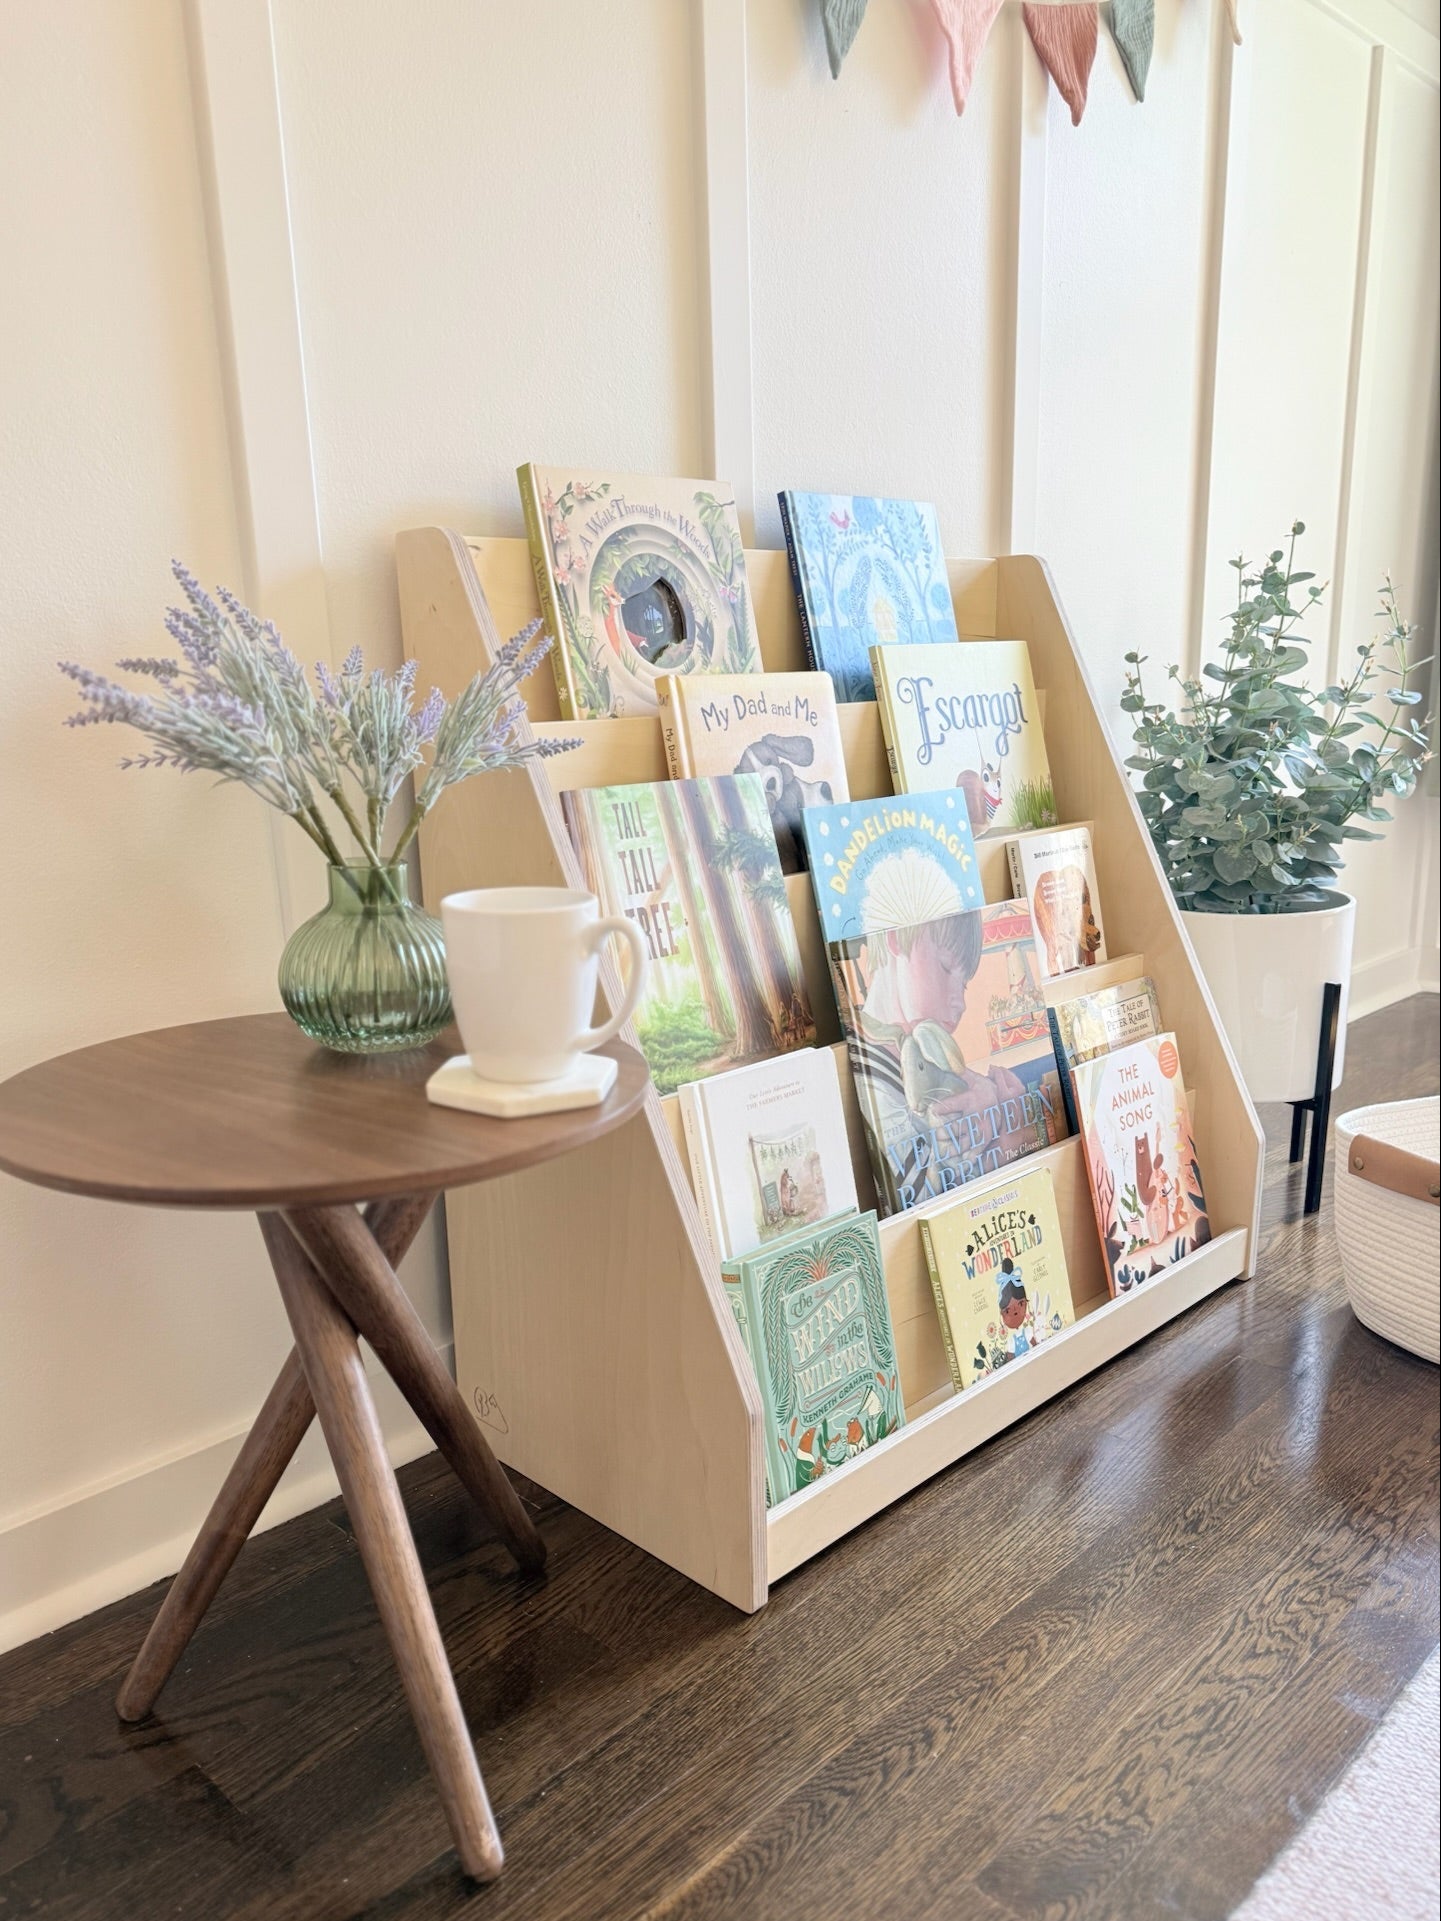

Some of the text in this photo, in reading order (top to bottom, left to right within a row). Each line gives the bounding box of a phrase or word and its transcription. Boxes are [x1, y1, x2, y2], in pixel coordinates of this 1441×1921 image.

[579, 494, 711, 559] A Walk Through the Woods
[796, 594, 804, 609] THE
[800, 611, 811, 648] LANTERN
[700, 691, 819, 732] My Dad and Me
[896, 676, 1029, 766] Escargot
[664, 728, 674, 743] My
[668, 744, 678, 762] Dad
[611, 801, 648, 840] TALL
[617, 847, 662, 895] TALL
[1120, 1001, 1137, 1014] TALE
[1136, 999, 1144, 1008] OF
[1127, 1008, 1150, 1025] RABBIT
[1118, 1063, 1139, 1084] THE
[783, 1086, 805, 1099] MARKET
[1111, 1080, 1155, 1112] ANIMAL
[883, 1123, 907, 1139] THE
[888, 1084, 1056, 1178] VELVETEEN
[1119, 1102, 1153, 1132] SONG
[1004, 1138, 1045, 1161] The Classic
[961, 1224, 1043, 1280] WONDERLAND
[791, 1292, 813, 1318] The
[790, 1279, 860, 1364] WIND
[837, 1321, 864, 1347] in the
[797, 1340, 869, 1398] WILLOWS
[802, 1372, 874, 1424] KENNETH GRAHAME
